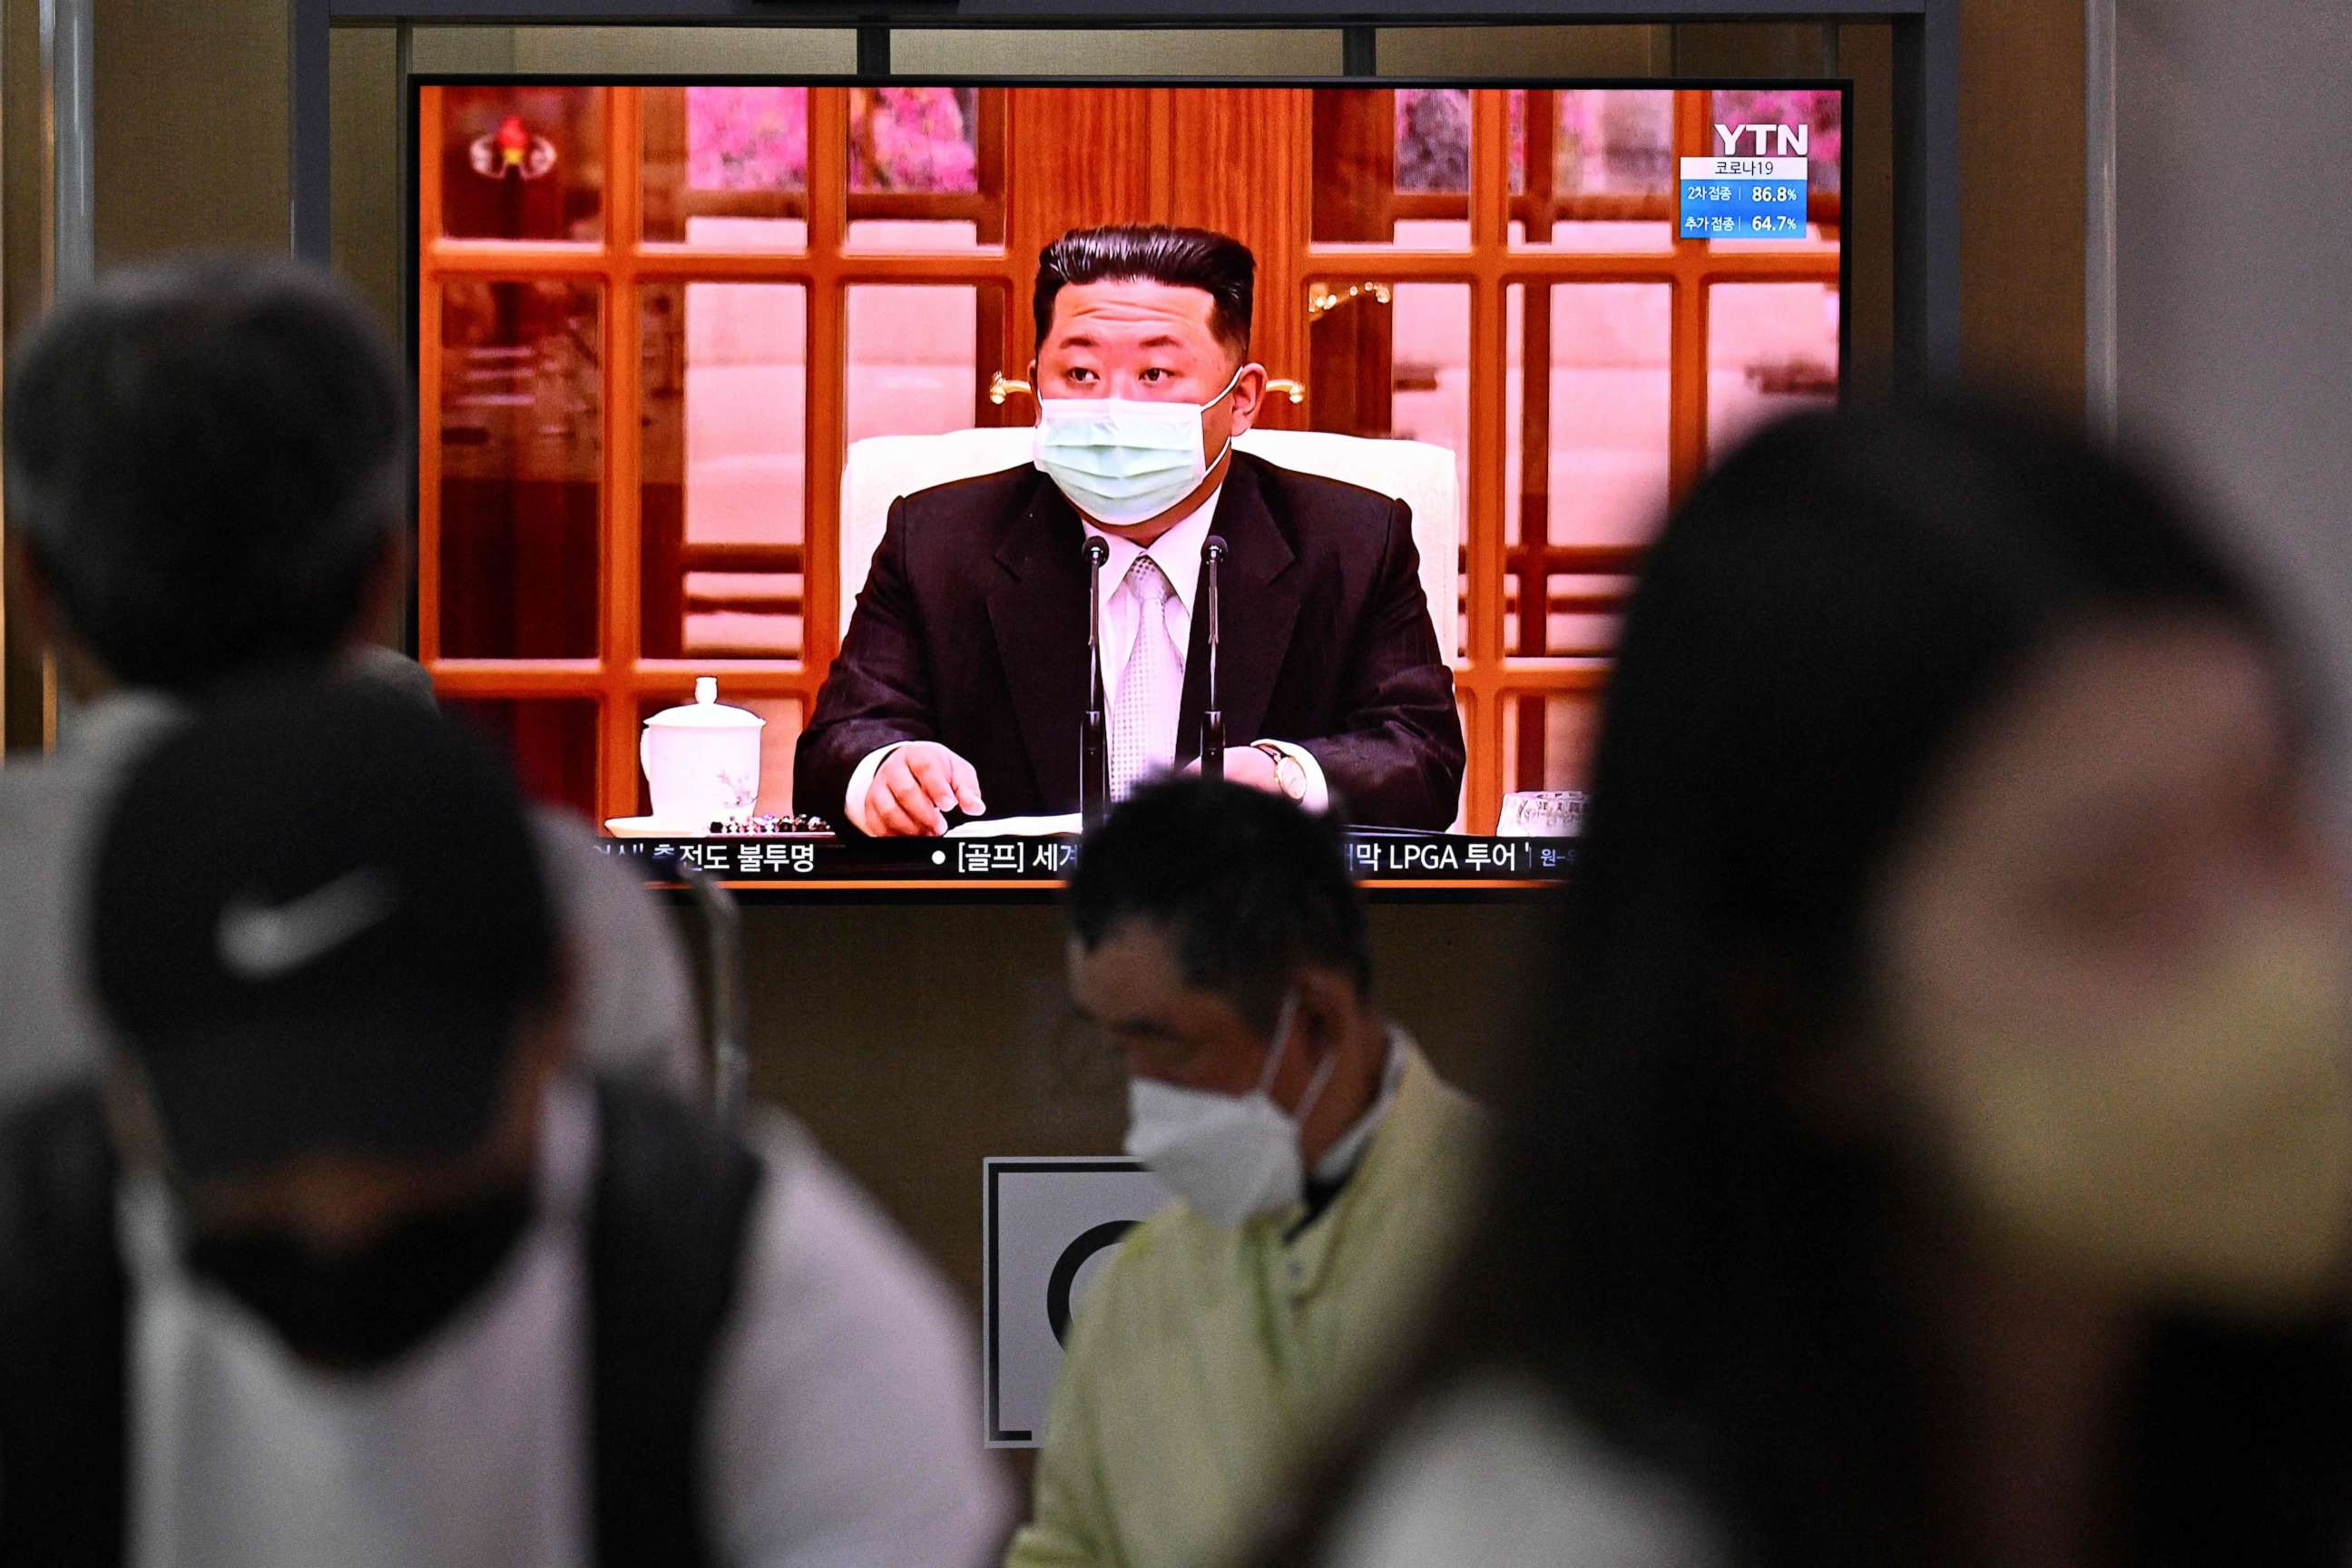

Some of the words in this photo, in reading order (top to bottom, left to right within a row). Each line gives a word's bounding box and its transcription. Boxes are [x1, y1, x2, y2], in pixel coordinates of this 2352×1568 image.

[1714, 123, 1808, 156] YTN
[1715, 161, 1774, 176] 코로나19
[1751, 186, 1798, 201] 86.8%
[1751, 216, 1798, 231] 64.7%
[737, 844, 815, 872] 불투명
[958, 842, 1024, 873] [골프]
[1389, 844, 1459, 869] LPGA
[1465, 843, 1515, 871] 투어
